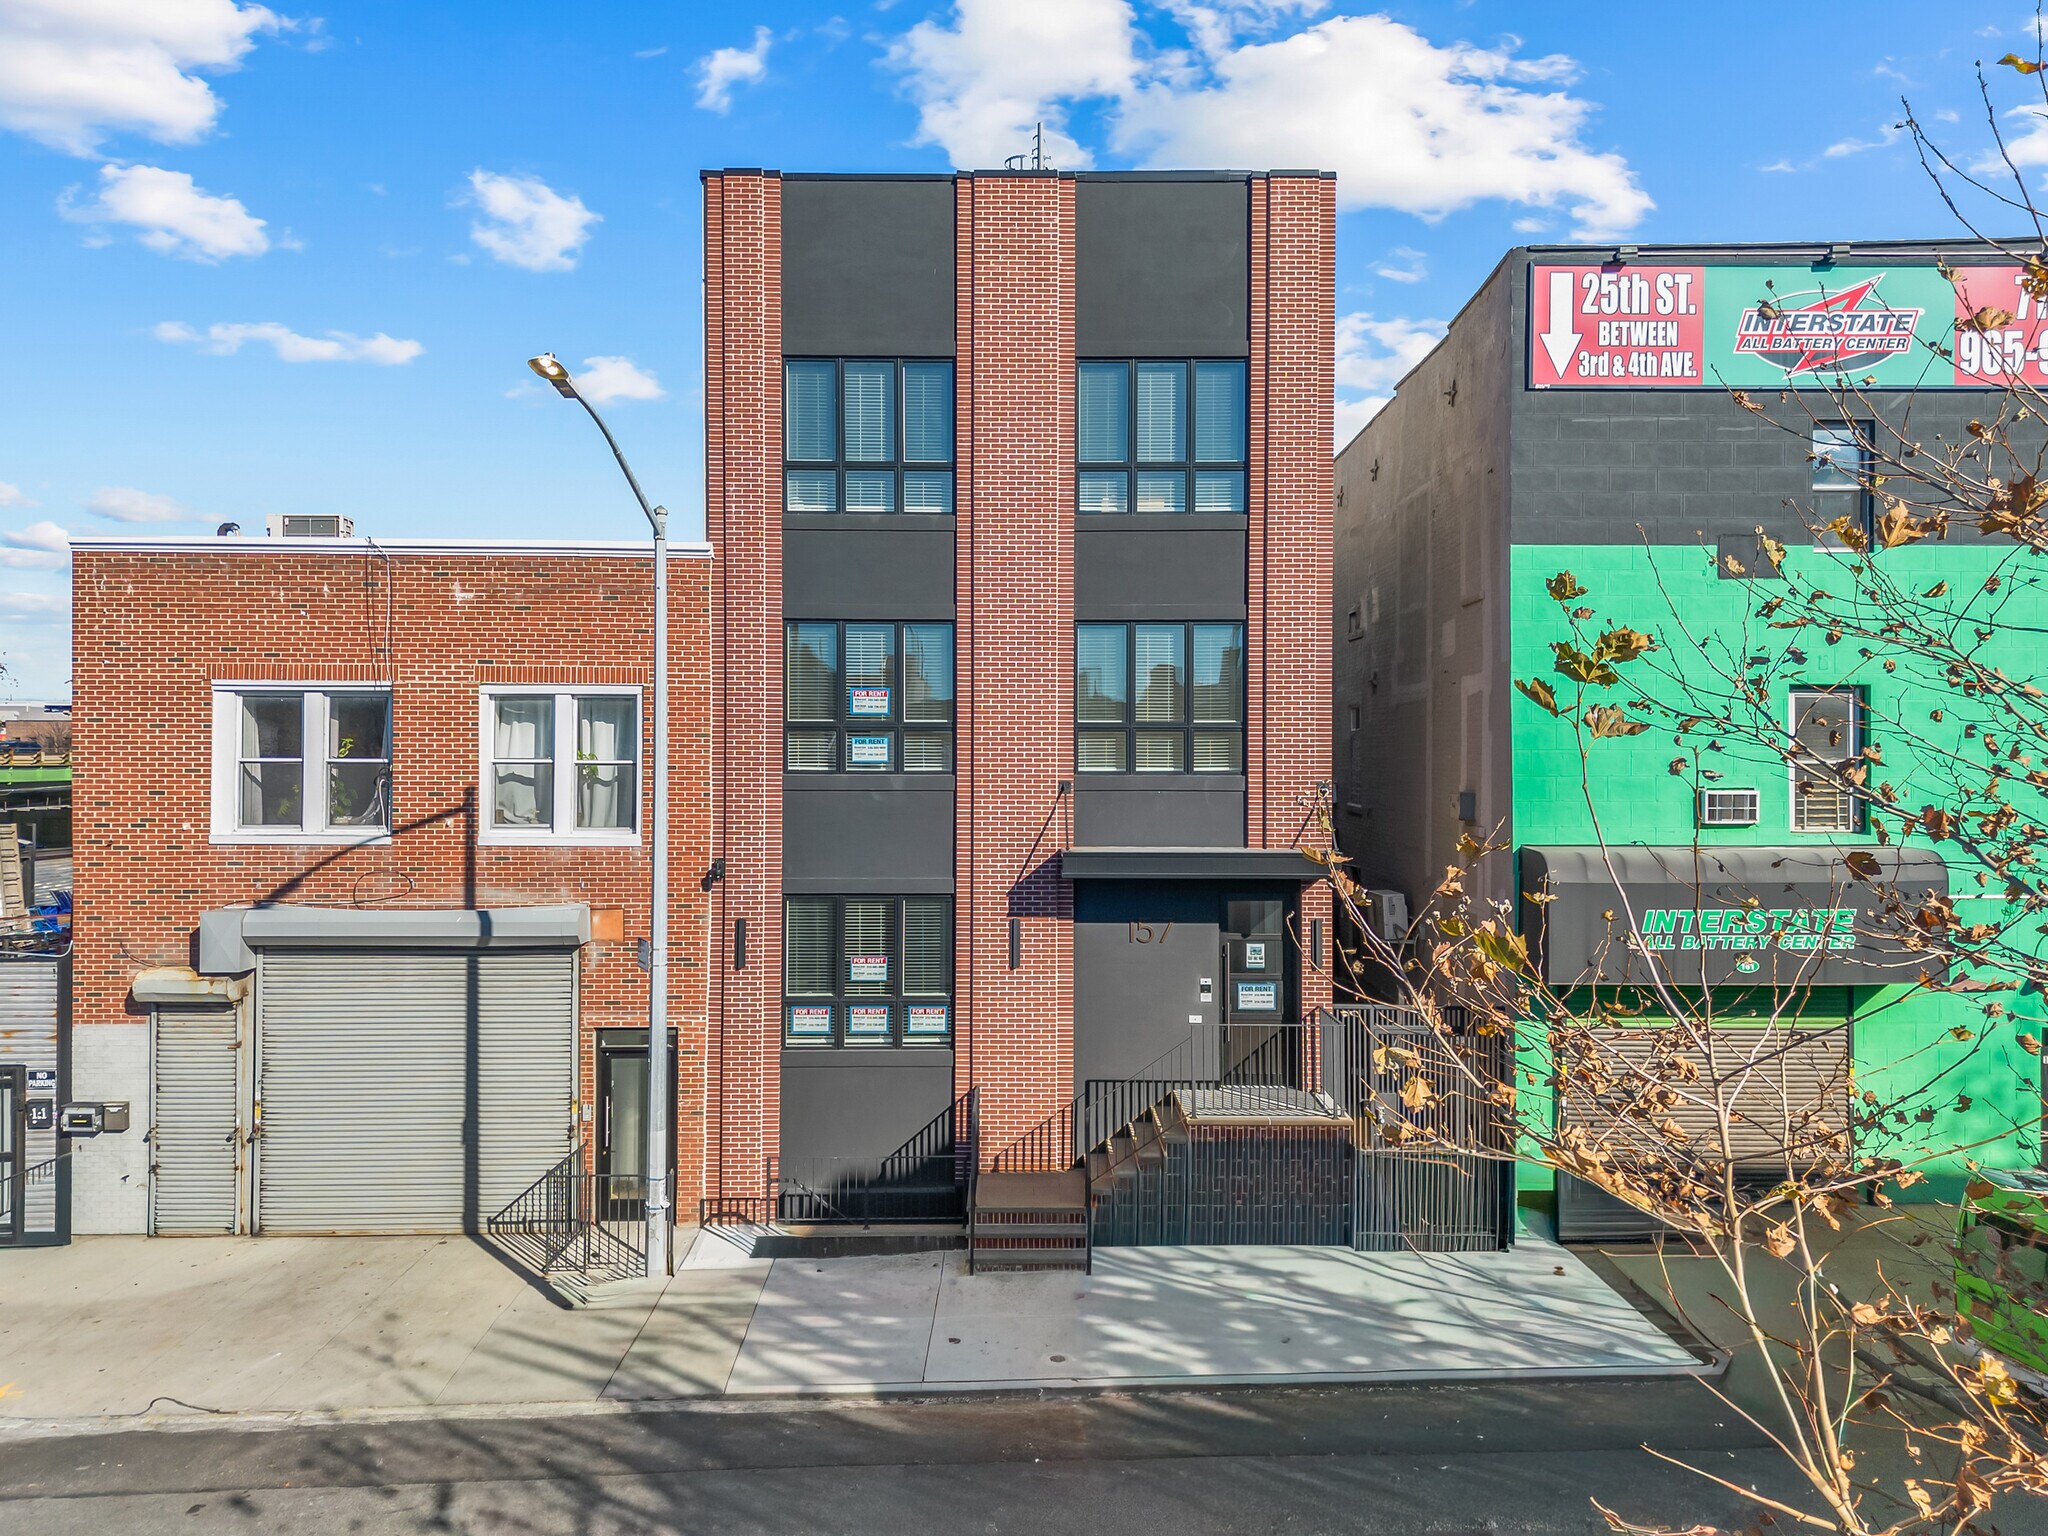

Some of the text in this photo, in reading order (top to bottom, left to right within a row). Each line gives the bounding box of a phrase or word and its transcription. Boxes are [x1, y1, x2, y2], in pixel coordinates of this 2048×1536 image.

[1581, 272, 1697, 315] 25th ST.
[1598, 320, 1678, 347] BETWEEN
[1743, 313, 1914, 332] INTERSTATE
[1741, 337, 1907, 349] ALL BATTERY CENTER
[1578, 350, 1698, 377] 3rd & 4th AVE.
[1128, 921, 1174, 945] 157
[1641, 908, 1858, 934] INTERSTATE
[1681, 934, 1771, 950] BATTERY
[29, 1080, 56, 1088] PARKING
